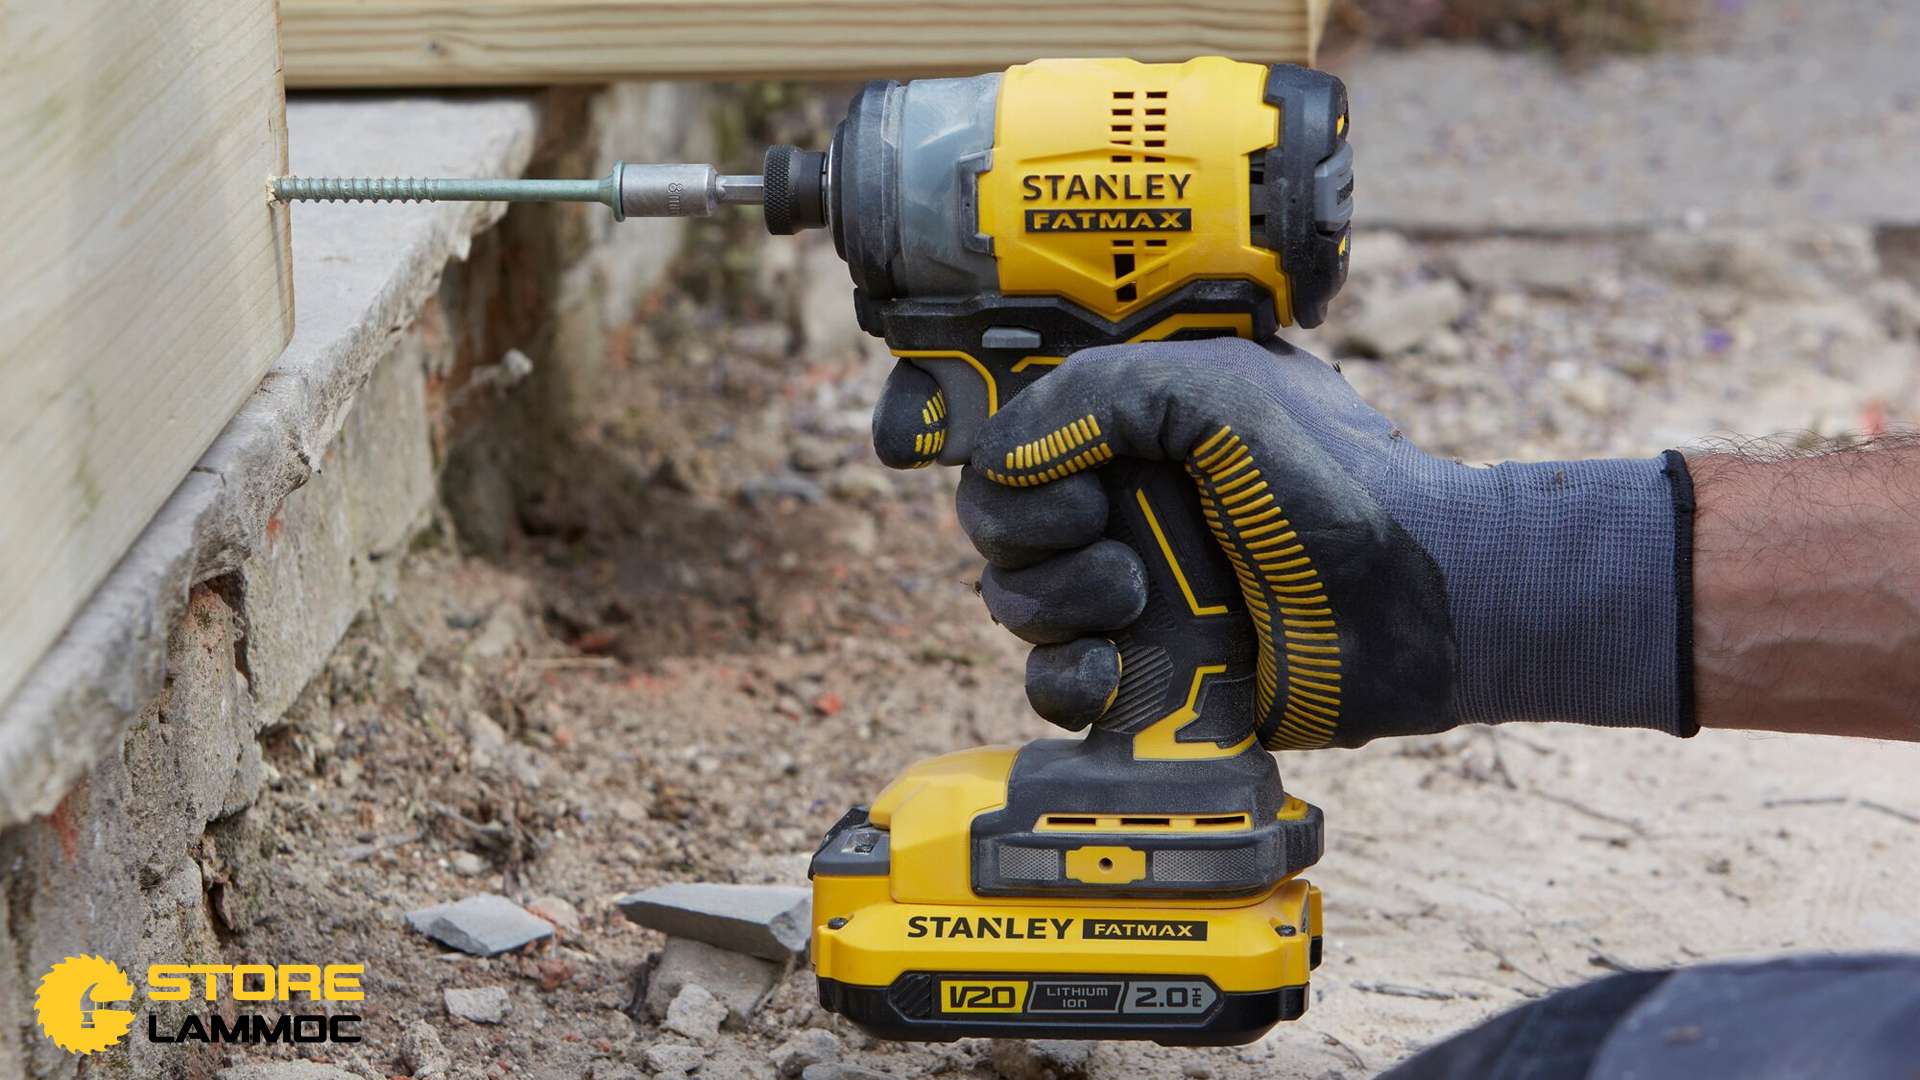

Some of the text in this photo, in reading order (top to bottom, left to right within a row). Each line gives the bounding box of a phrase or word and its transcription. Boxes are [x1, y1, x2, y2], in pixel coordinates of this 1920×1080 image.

[1022, 174, 1192, 201] STANLEY
[1033, 213, 1181, 229] FATMAX
[907, 916, 1193, 940] STANLEY FATMAX
[949, 986, 1016, 1009] V20
[1135, 986, 1188, 1008] 2.0
